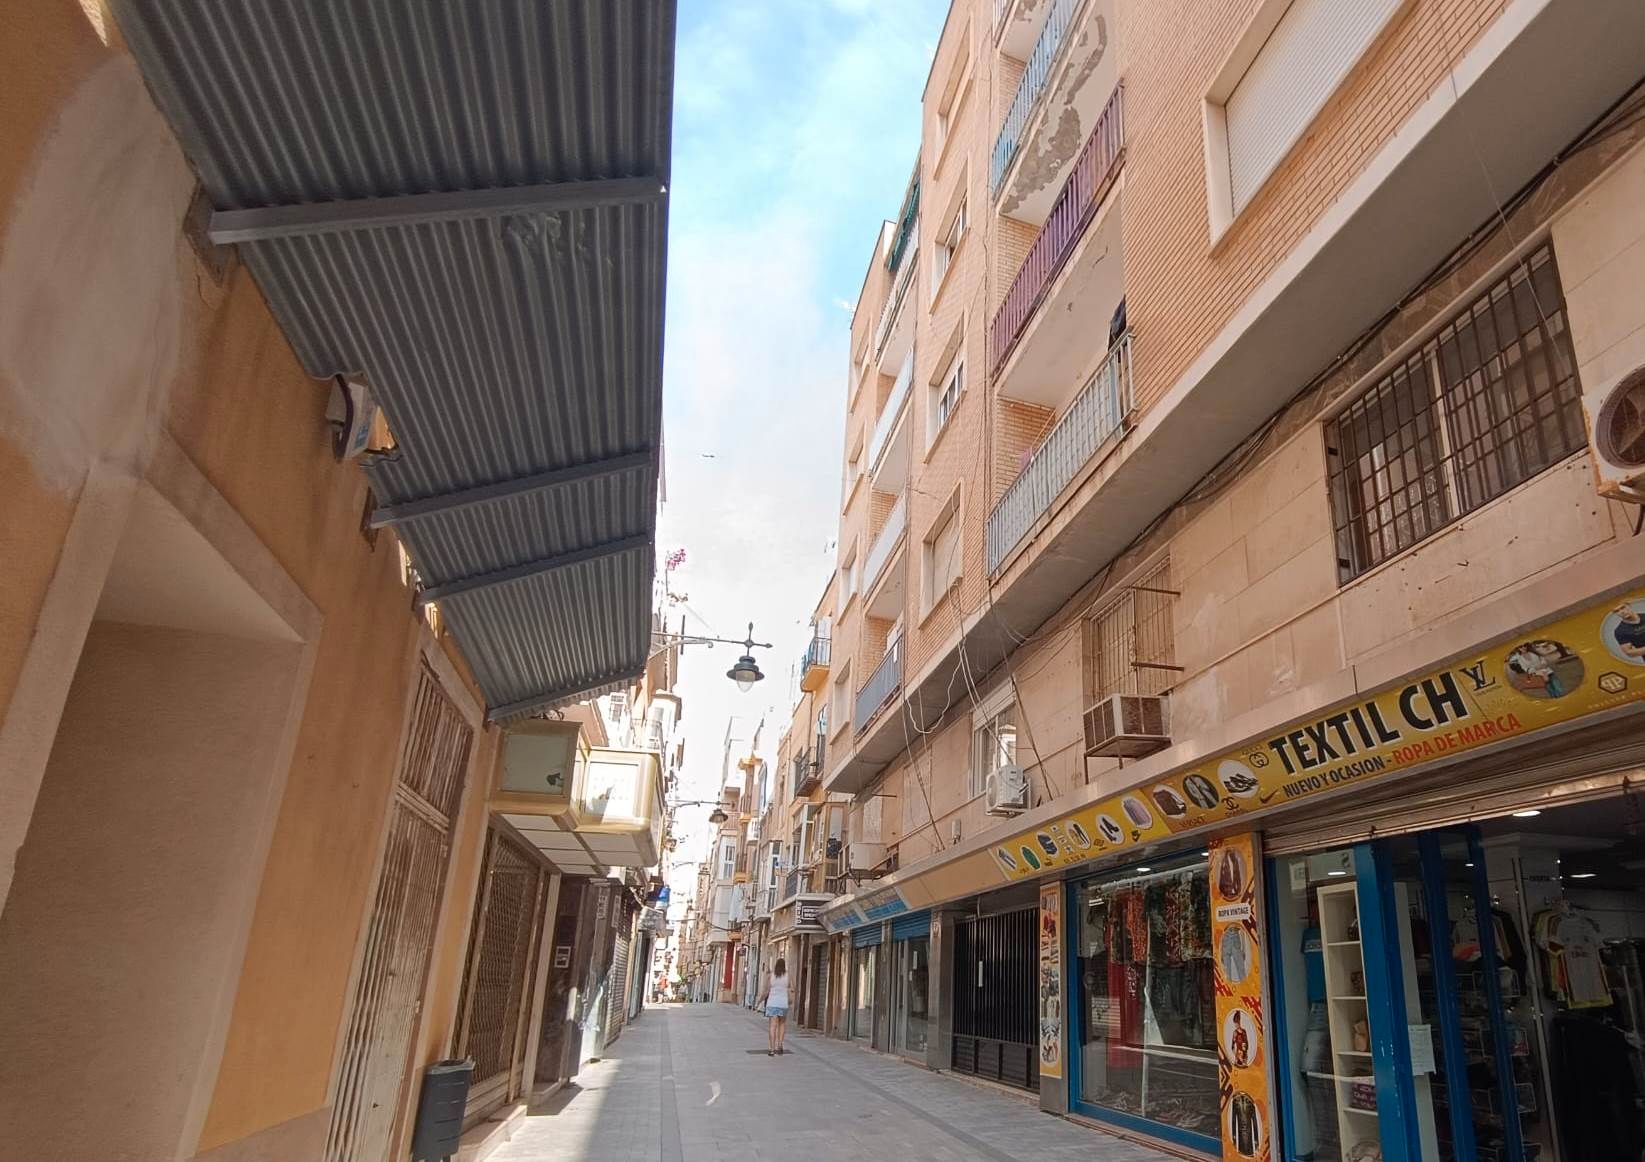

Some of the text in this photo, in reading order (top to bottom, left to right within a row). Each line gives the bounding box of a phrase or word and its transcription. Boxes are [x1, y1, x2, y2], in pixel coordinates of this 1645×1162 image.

[1268, 671, 1469, 776] TEXTIL CH
[1282, 776, 1321, 798] NUEVO
[1319, 774, 1330, 787] Y
[1329, 755, 1386, 783] OCASION
[1392, 740, 1434, 765] ROPA
[1434, 732, 1457, 752] DE
[1457, 712, 1522, 745] MARCA
